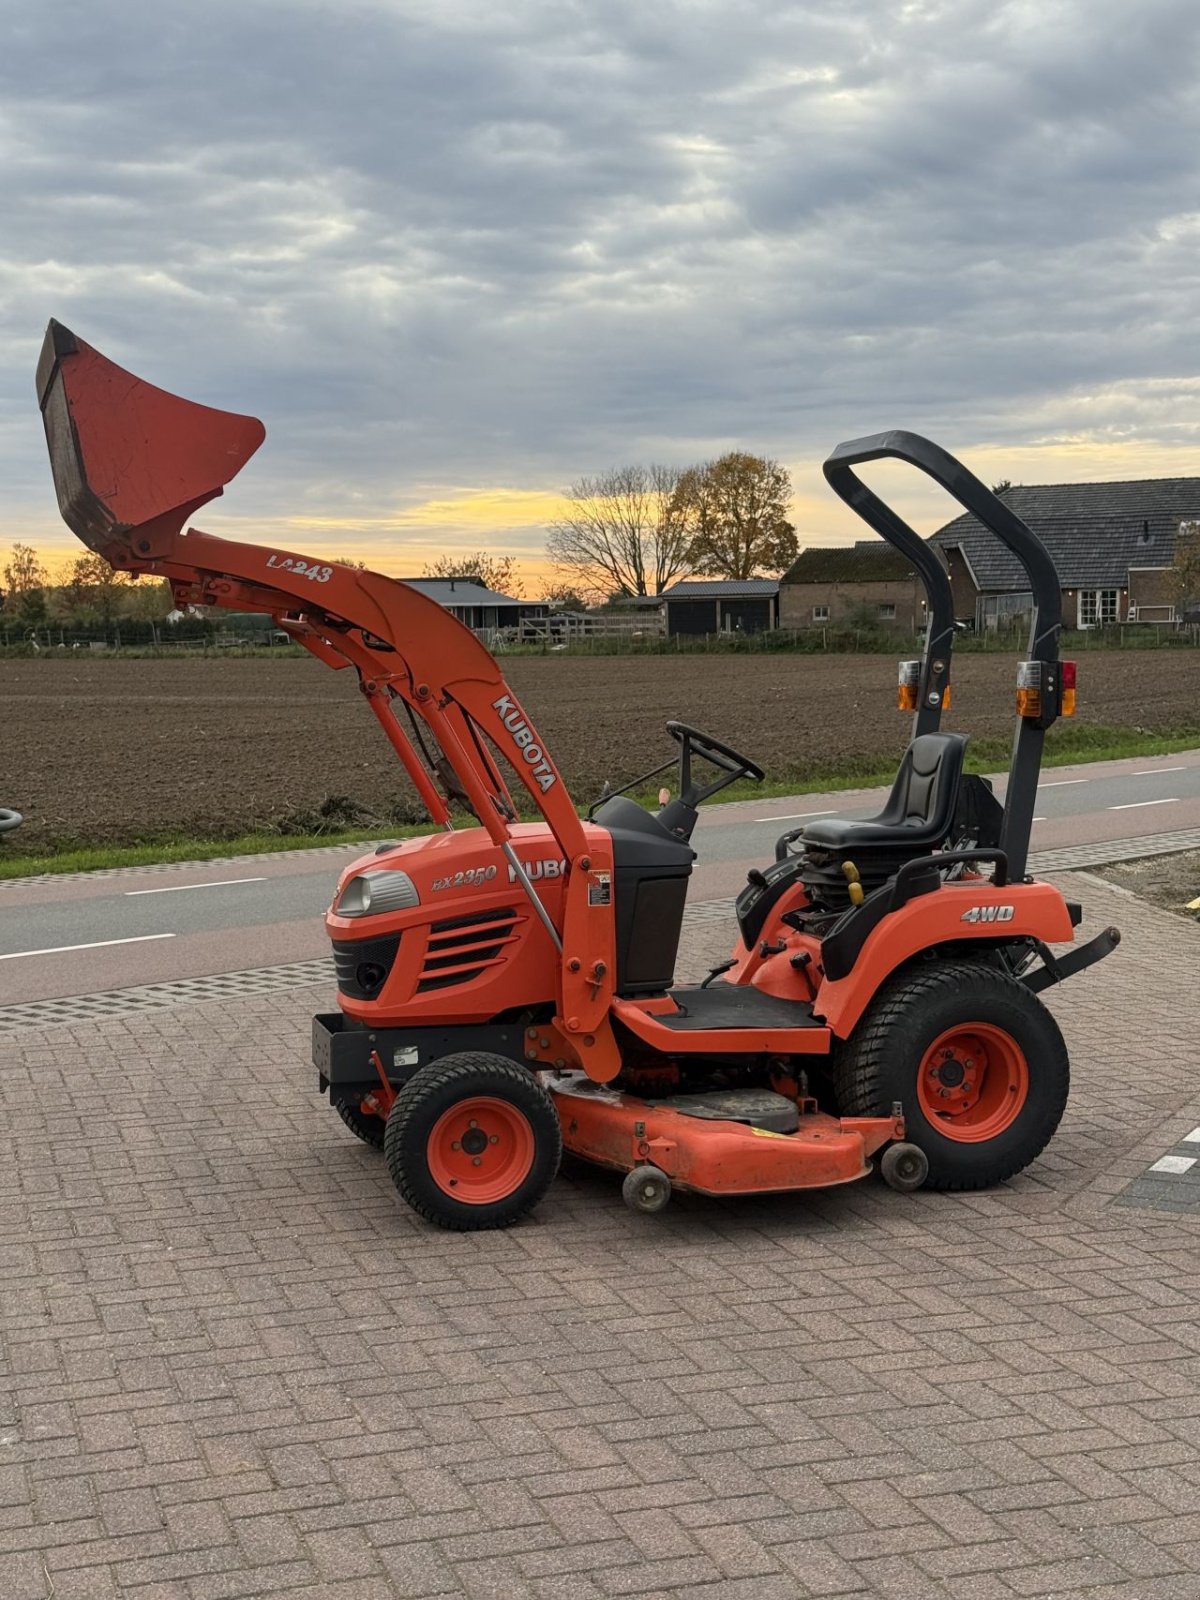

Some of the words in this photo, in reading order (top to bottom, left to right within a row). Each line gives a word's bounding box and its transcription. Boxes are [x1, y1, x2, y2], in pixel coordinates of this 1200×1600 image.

[266, 554, 334, 583] LA243
[491, 694, 557, 793] KUBOTA
[960, 905, 1015, 923] 4WD
